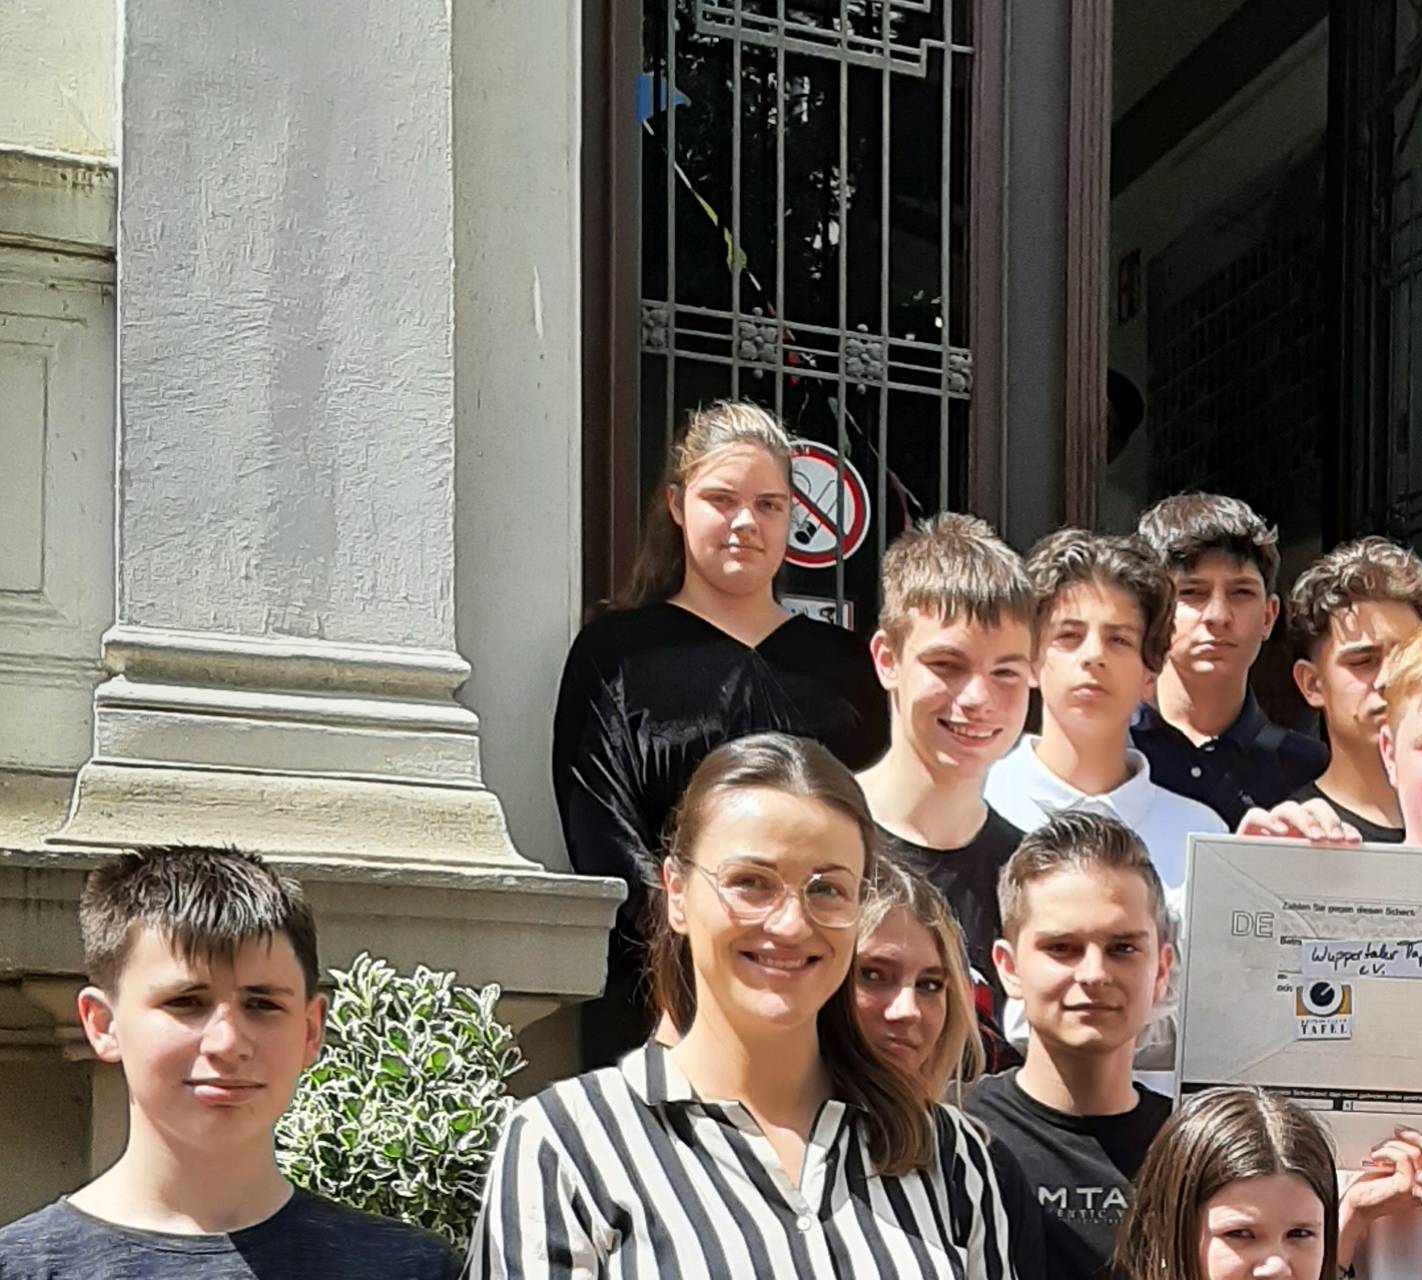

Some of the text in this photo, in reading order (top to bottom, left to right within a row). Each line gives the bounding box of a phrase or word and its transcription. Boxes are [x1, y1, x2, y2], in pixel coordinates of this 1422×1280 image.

[1328, 905, 1354, 914] gegen
[1231, 911, 1275, 938] DE
[1301, 1023, 1348, 1035] TAFEL
